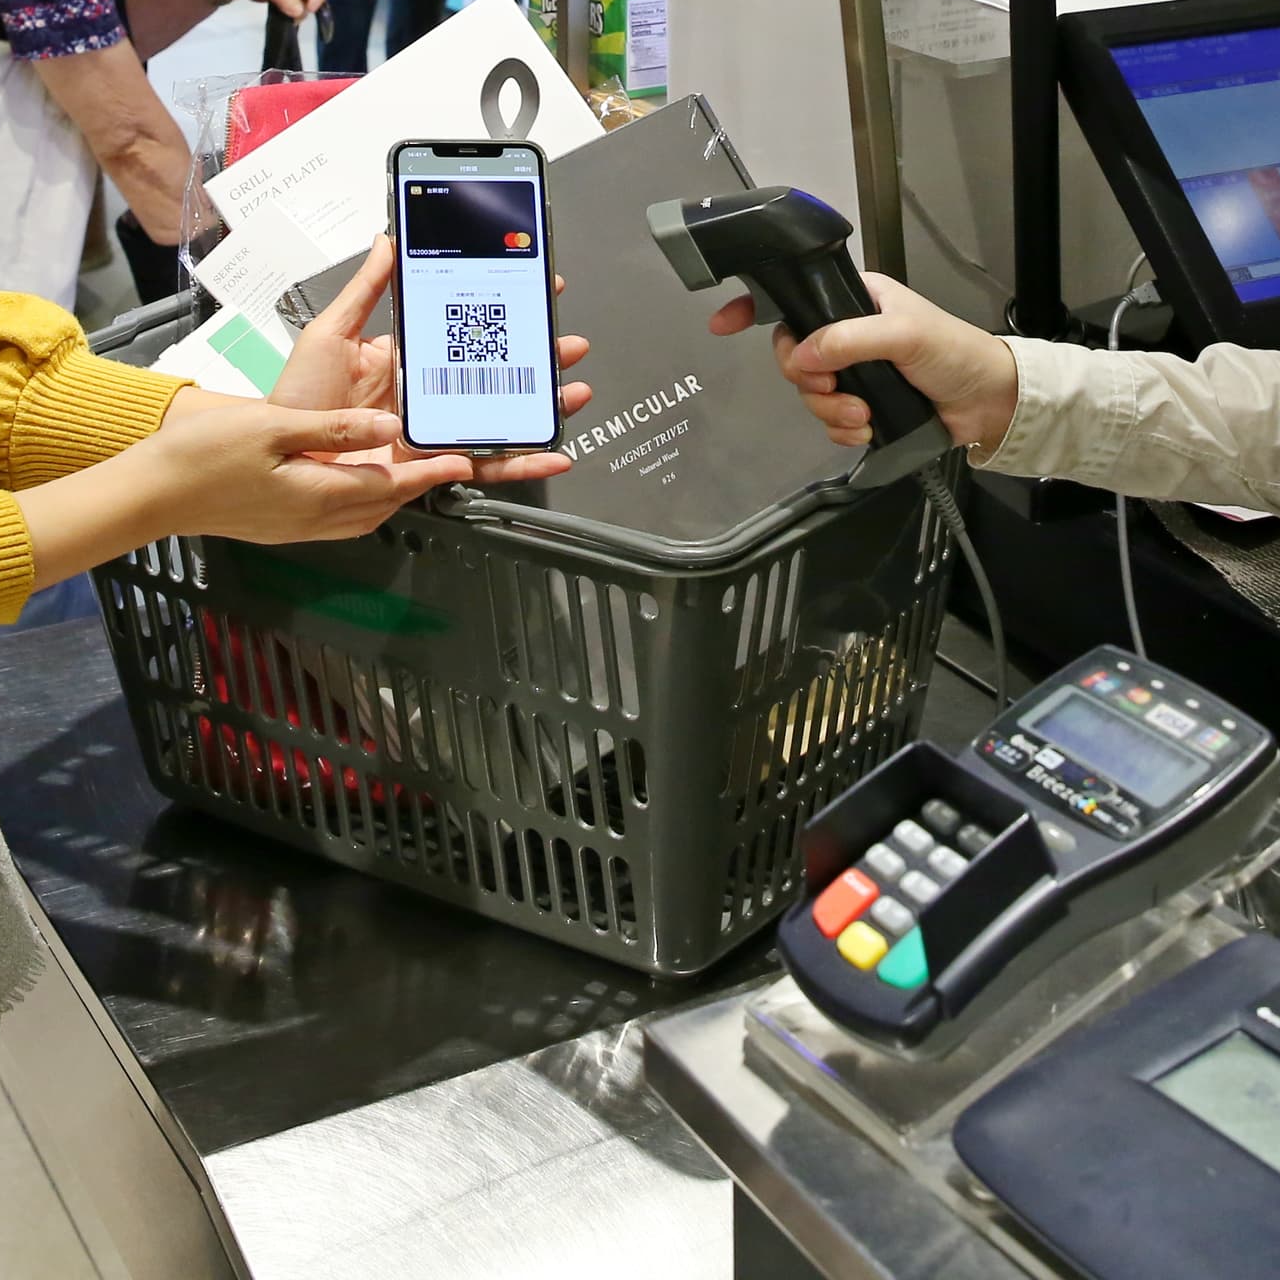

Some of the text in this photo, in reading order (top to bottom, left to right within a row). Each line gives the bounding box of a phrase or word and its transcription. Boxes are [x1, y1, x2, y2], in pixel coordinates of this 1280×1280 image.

[229, 168, 273, 201] GRILL
[282, 152, 328, 189] PLATE
[213, 247, 251, 284] SERVER
[223, 266, 249, 293] TONG
[561, 374, 703, 461] VERMICULAR
[609, 419, 689, 473] MAGNET TRIVET
[638, 447, 680, 477] Natural Wood
